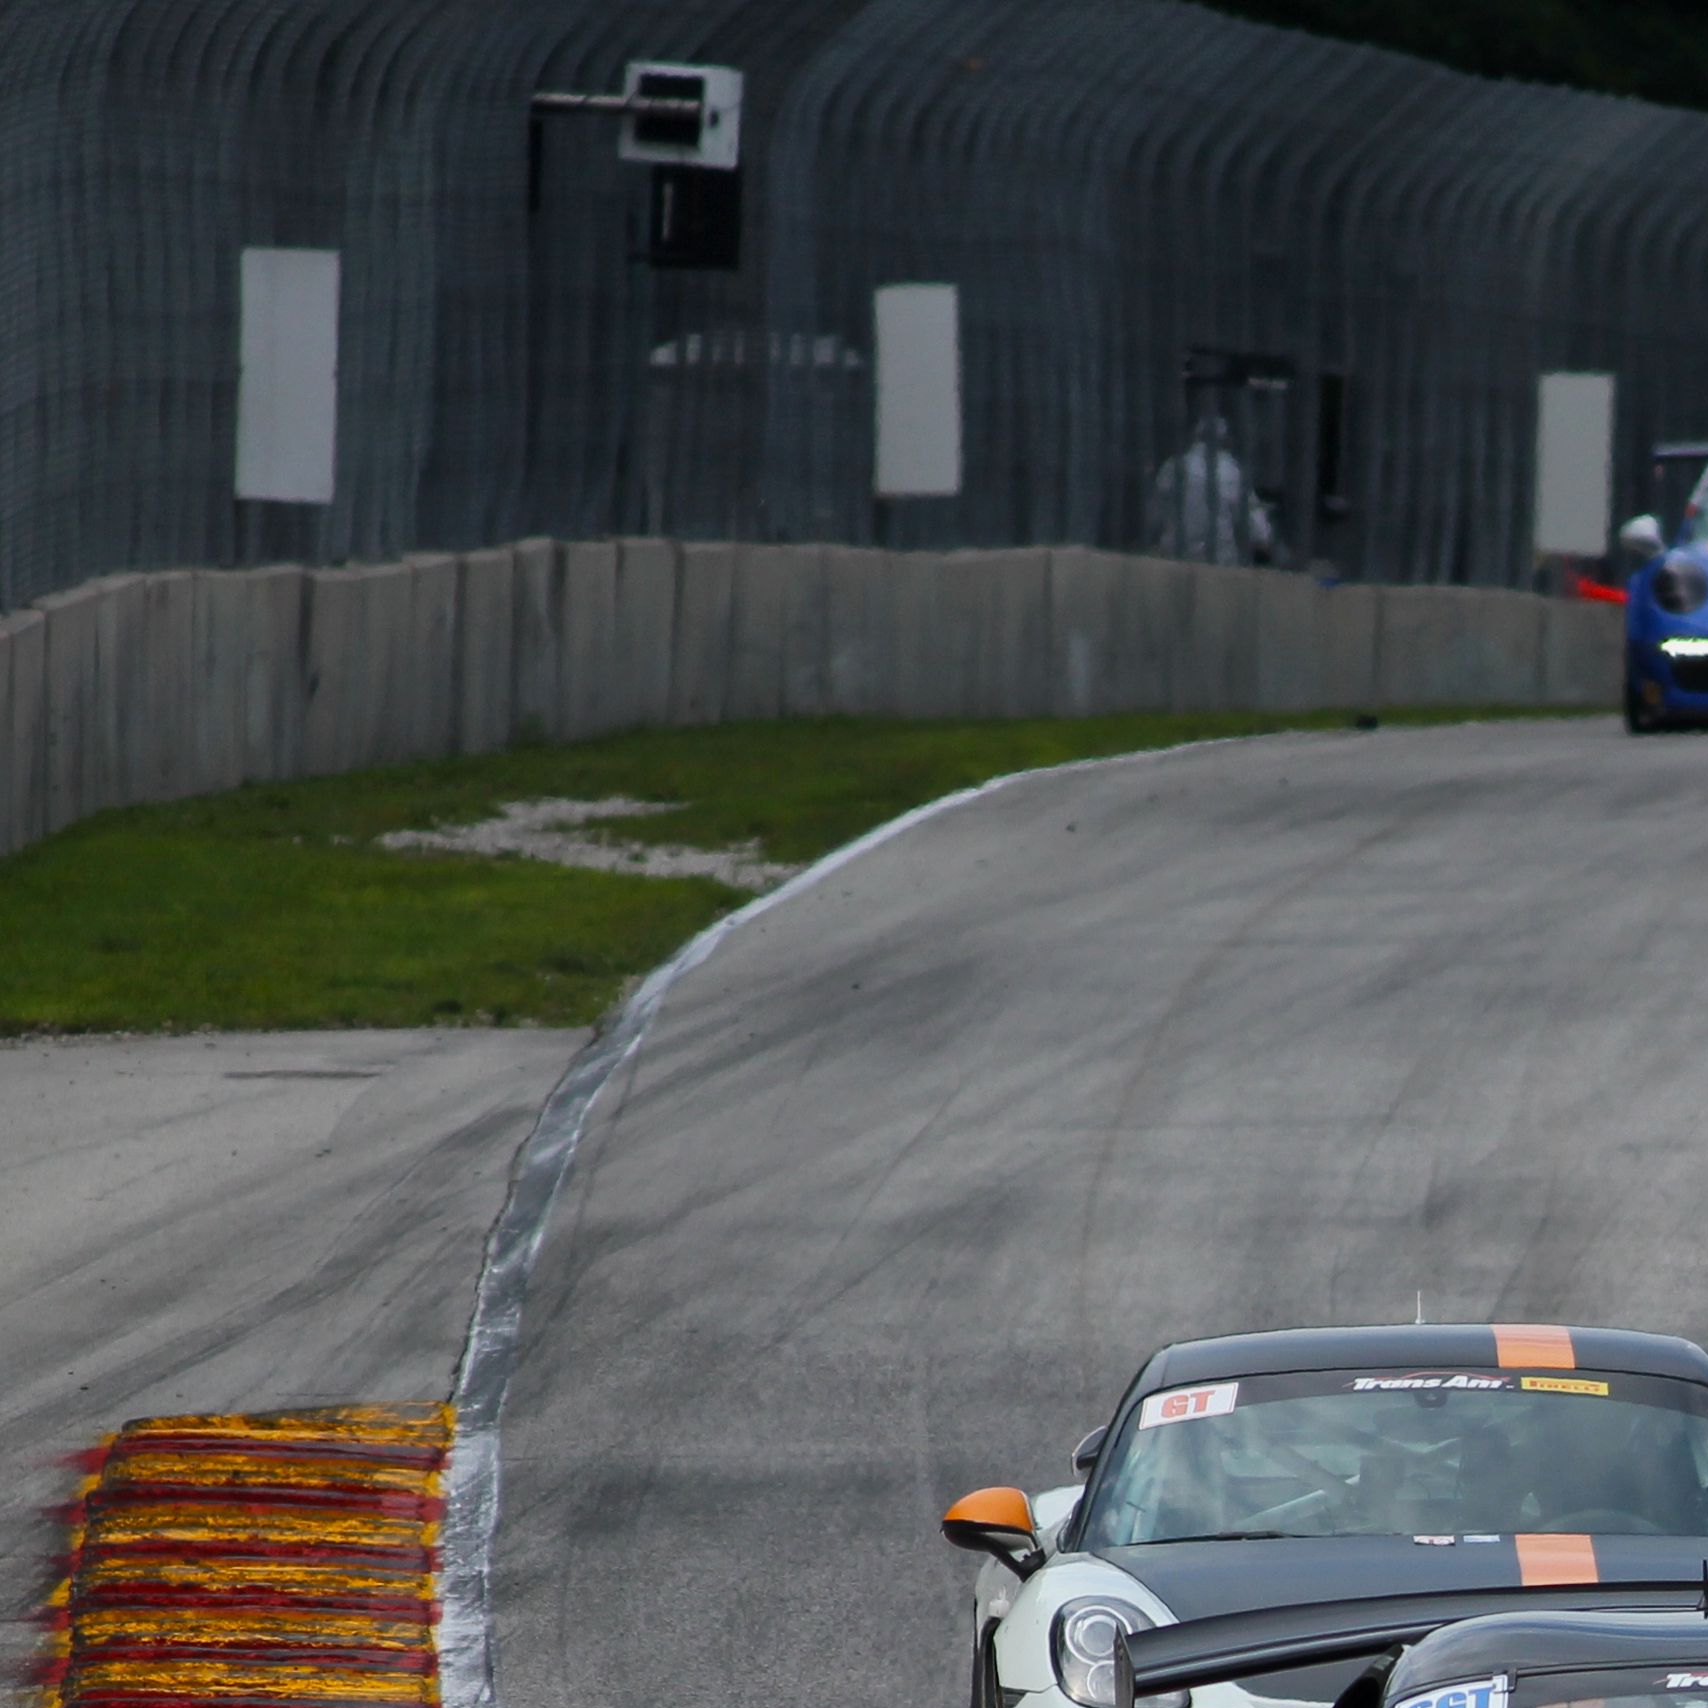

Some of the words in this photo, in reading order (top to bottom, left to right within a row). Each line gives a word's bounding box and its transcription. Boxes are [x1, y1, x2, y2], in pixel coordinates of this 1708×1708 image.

[1353, 1376, 1442, 1391] Trans
[1443, 1375, 1502, 1389] Am
[1161, 1389, 1217, 1418] GT
